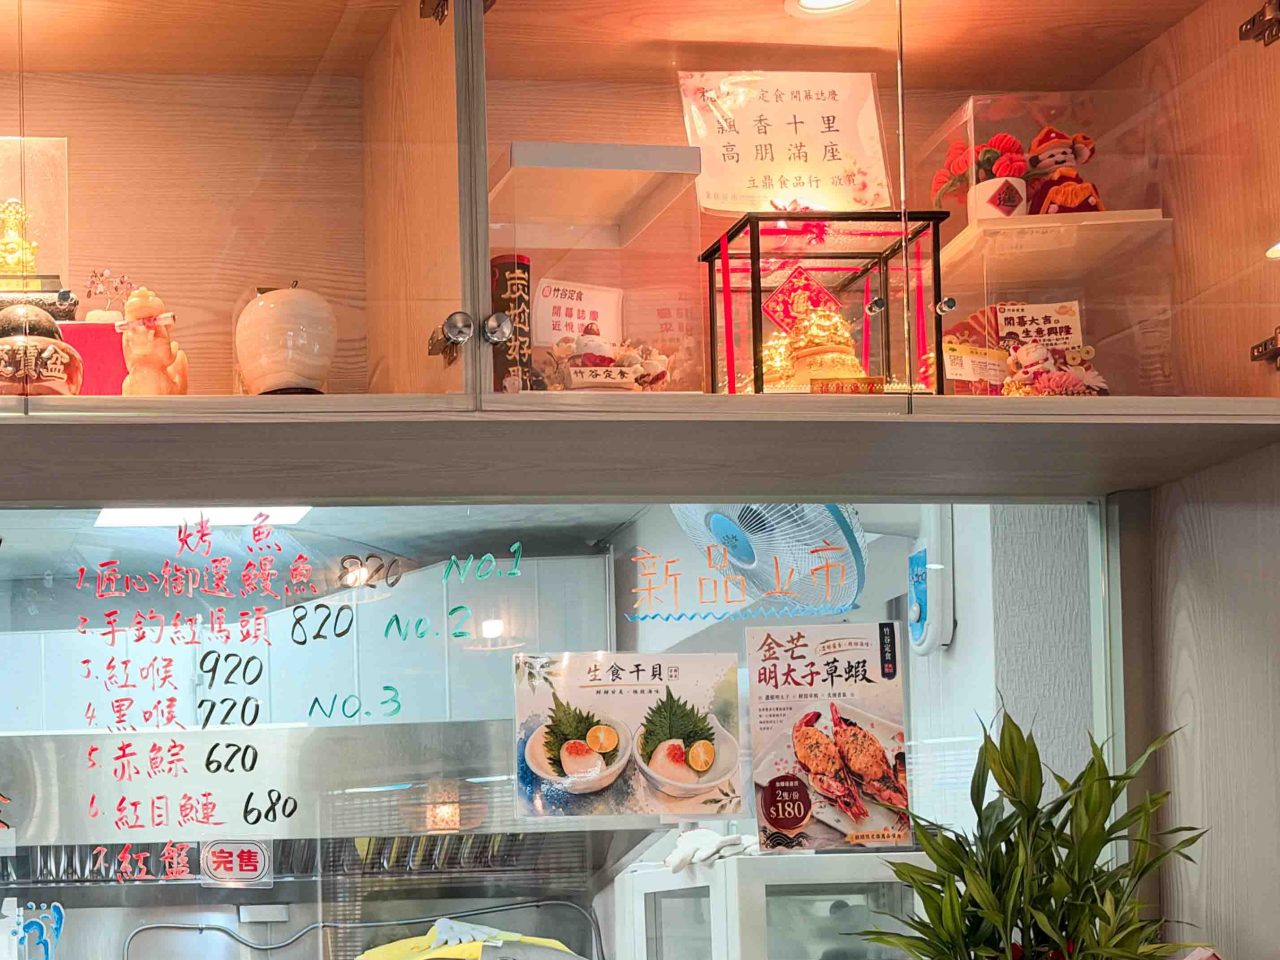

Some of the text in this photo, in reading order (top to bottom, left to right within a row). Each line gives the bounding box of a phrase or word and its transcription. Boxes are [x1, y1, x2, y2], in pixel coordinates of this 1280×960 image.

[717, 114, 840, 135] 飄香十里
[722, 142, 842, 164] 高朋滿座
[552, 287, 584, 302] 竹谷定食
[573, 368, 630, 381] 竹谷定食
[177, 510, 282, 556] 烤魚
[631, 540, 849, 612] 新品上市
[291, 603, 354, 646] 820
[757, 632, 809, 662] 金芒
[199, 649, 264, 690] 920
[587, 662, 664, 683] 生食干貝
[757, 657, 878, 690] 明太子草蝦
[197, 696, 261, 732] 720
[204, 741, 259, 774] 620
[242, 788, 299, 825] 680
[770, 801, 805, 819] $180
[210, 846, 260, 874] 完售
